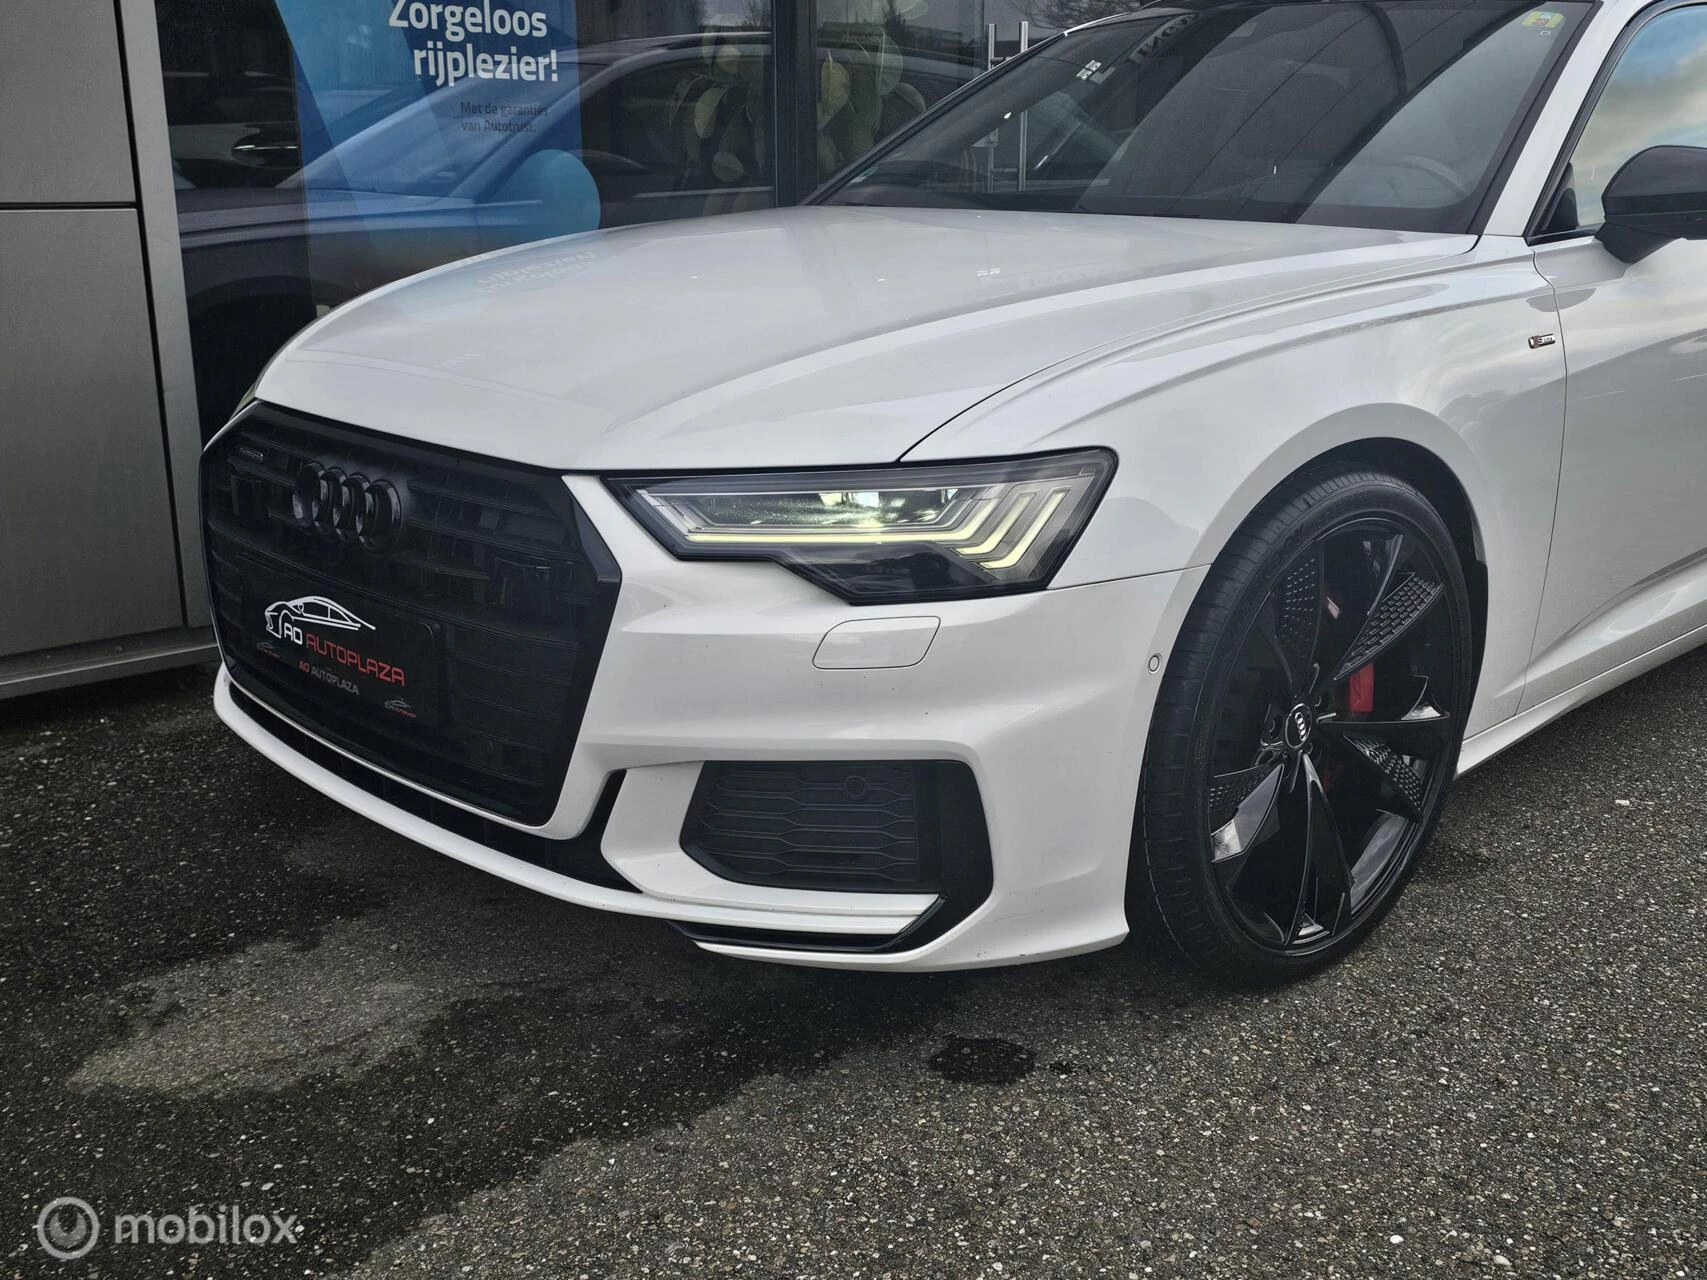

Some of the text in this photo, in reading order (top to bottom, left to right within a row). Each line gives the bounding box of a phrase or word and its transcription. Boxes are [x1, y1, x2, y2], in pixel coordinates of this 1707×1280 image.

[389, 0, 548, 42] Zorgeloos
[413, 41, 558, 87] rijplezier!
[460, 102, 482, 115] Met
[485, 102, 498, 115] de
[461, 121, 481, 132] van
[305, 632, 405, 687] AUTOPLAZA
[311, 666, 360, 696] AUTOPLAZA
